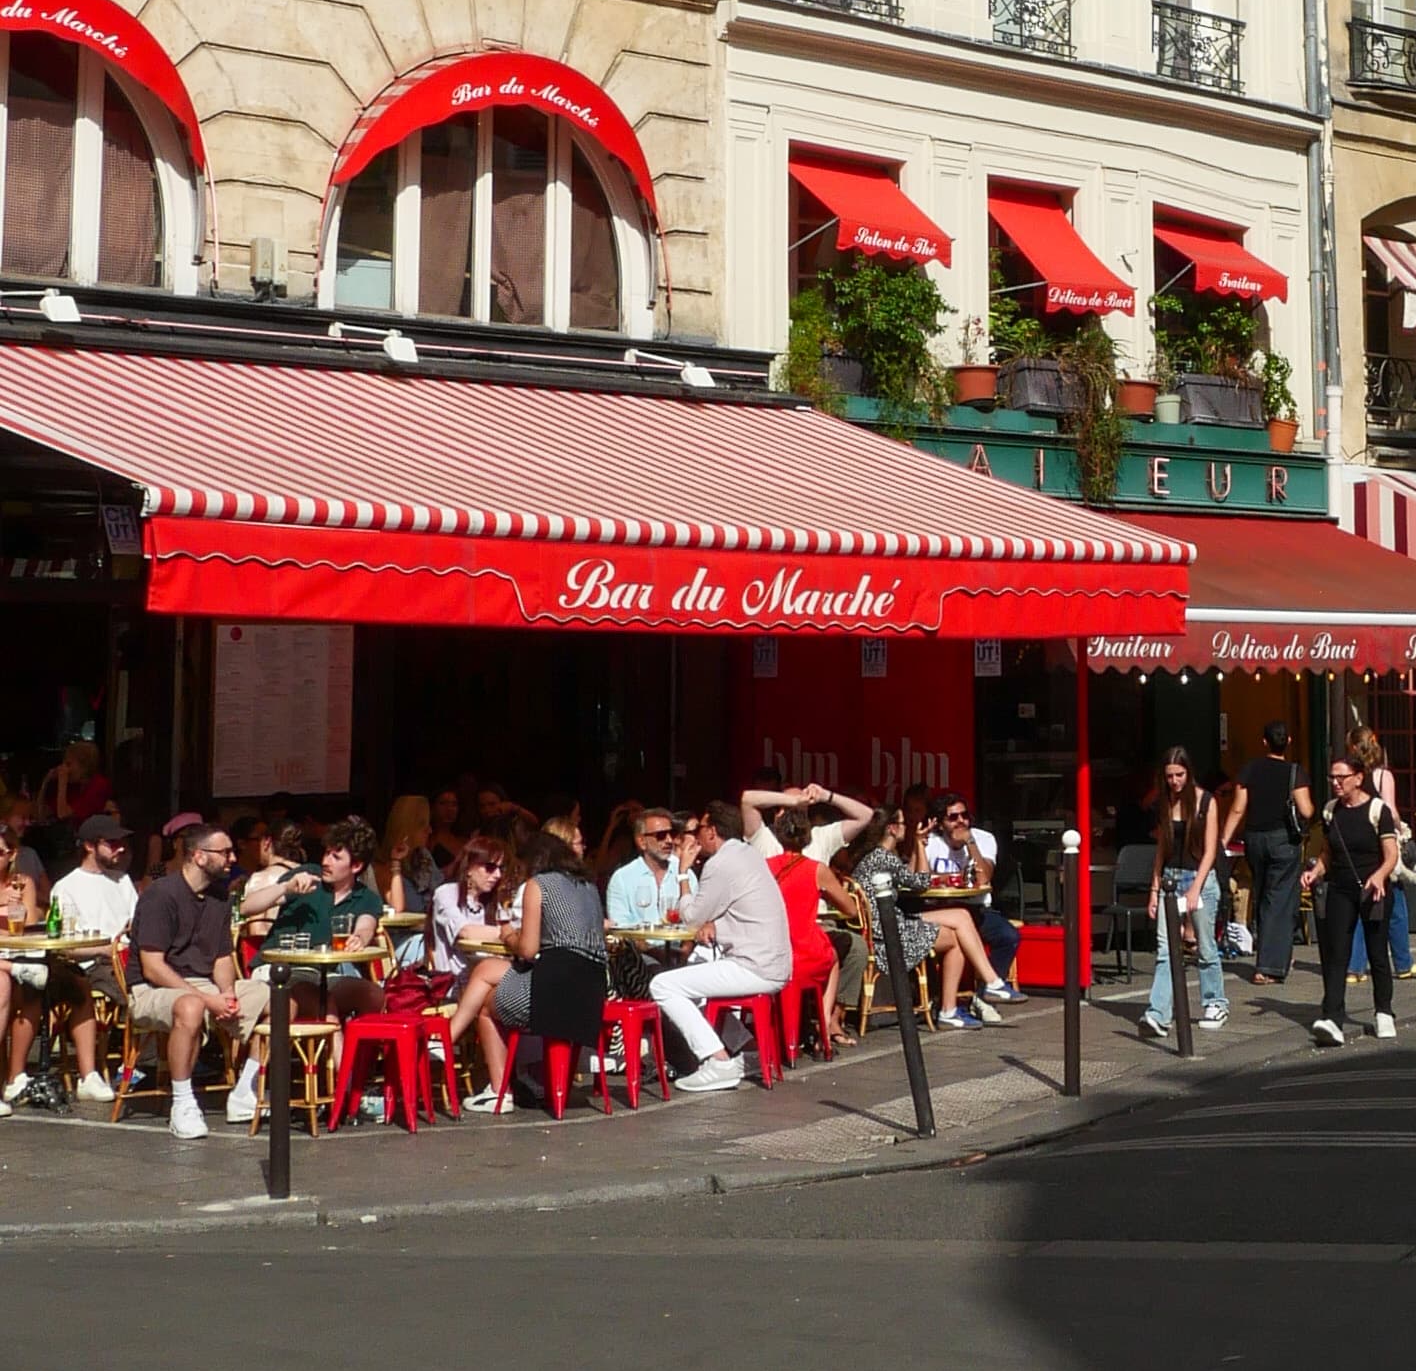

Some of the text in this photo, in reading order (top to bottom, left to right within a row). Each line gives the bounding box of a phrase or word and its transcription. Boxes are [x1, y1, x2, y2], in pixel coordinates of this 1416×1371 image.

[40, 7, 128, 58] Marché
[451, 77, 599, 128] Bar du Marché
[854, 227, 937, 256] Salon de Thé
[1218, 272, 1262, 292] Traiteur
[1088, 291, 1103, 306] de
[1104, 291, 1133, 308] Buci
[558, 557, 902, 618] Bar du Marché
[977, 645, 1000, 662] UT!
[1086, 630, 1359, 660] Traiteur Delices de Buci
